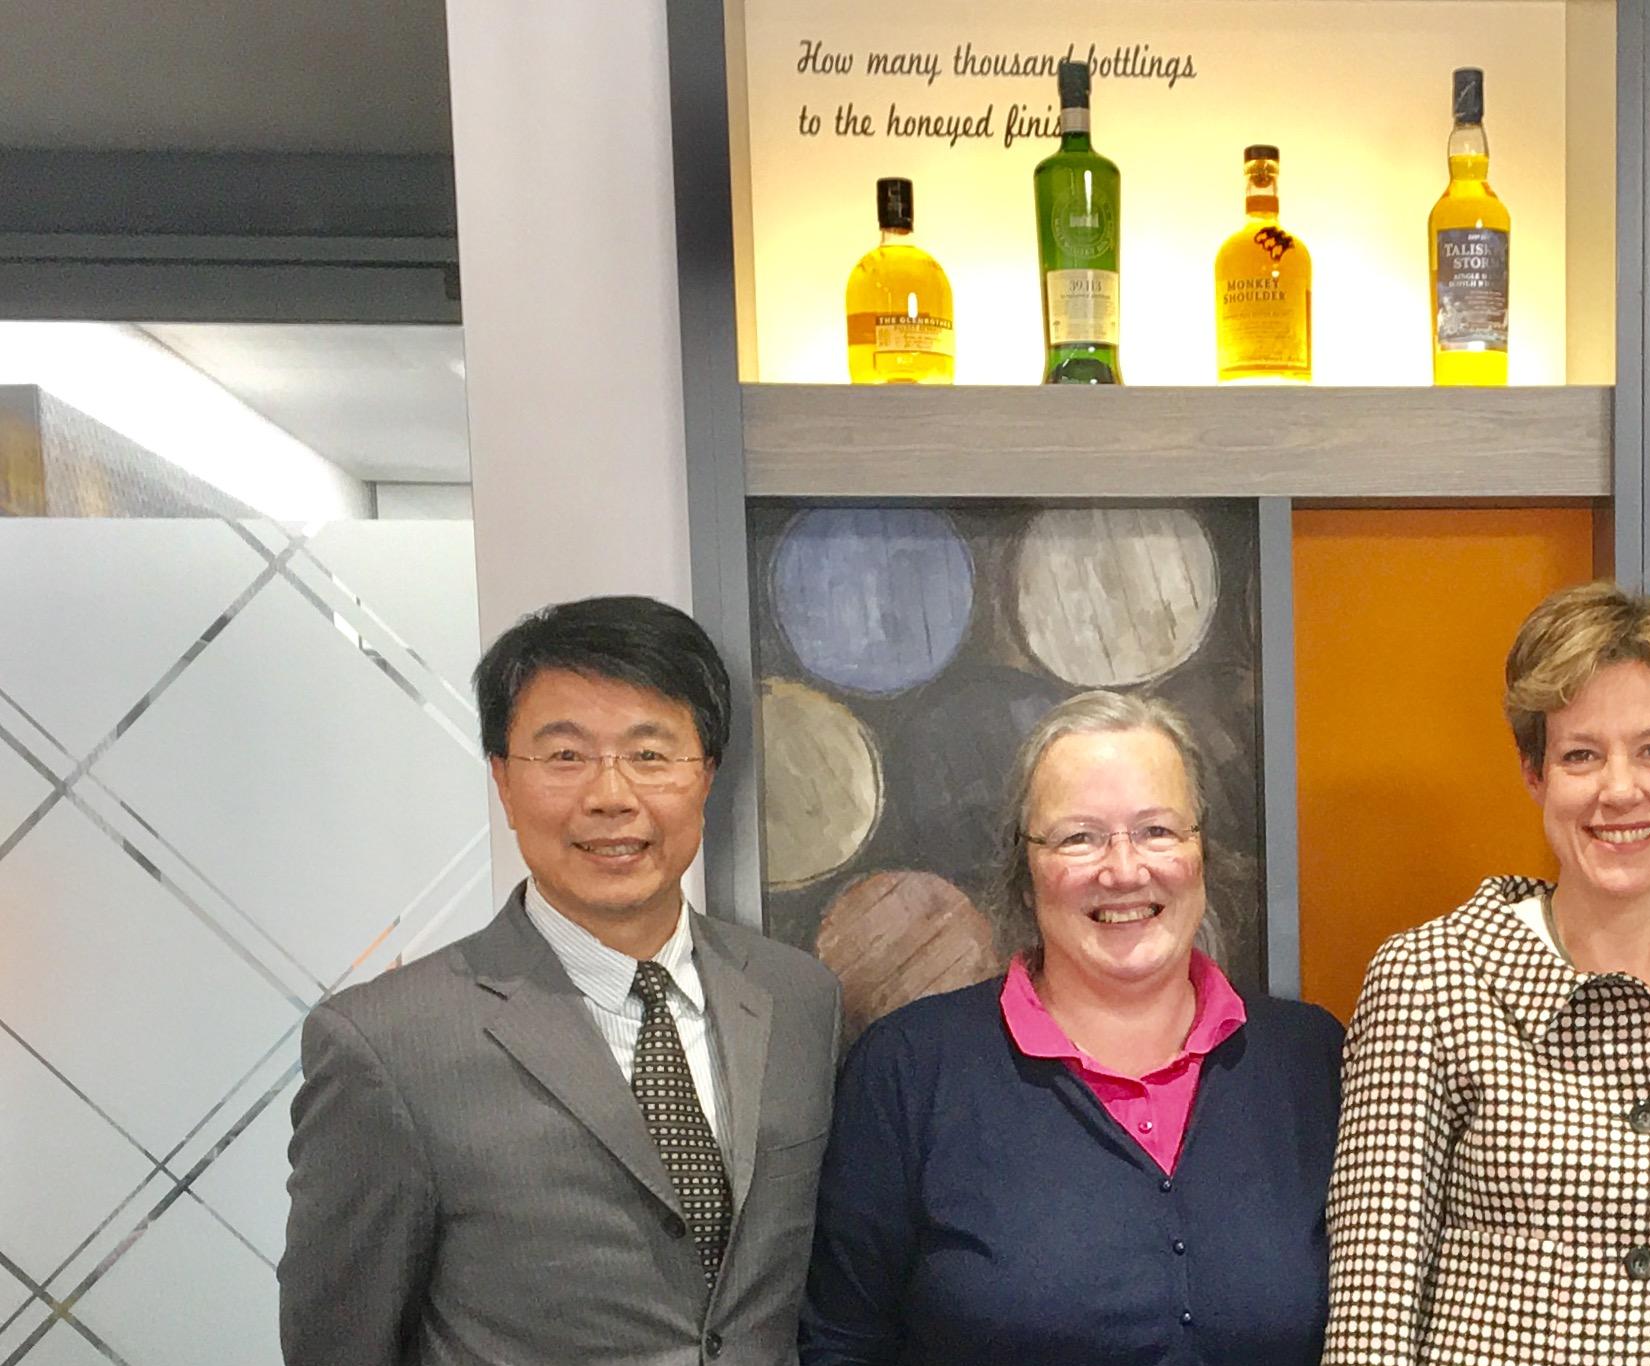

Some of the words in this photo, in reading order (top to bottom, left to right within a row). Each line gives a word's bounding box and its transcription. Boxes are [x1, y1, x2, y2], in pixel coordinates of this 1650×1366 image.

[797, 39, 853, 75] How
[866, 49, 942, 86] many
[953, 43, 1074, 77] thousand
[1087, 43, 1197, 88] bottlings
[799, 104, 822, 137] to
[835, 102, 875, 137] the
[886, 103, 994, 148] honeyed
[1005, 104, 1063, 148] finis
[1224, 290, 1285, 304] SHOULDER
[1228, 277, 1280, 291] MONKEY
